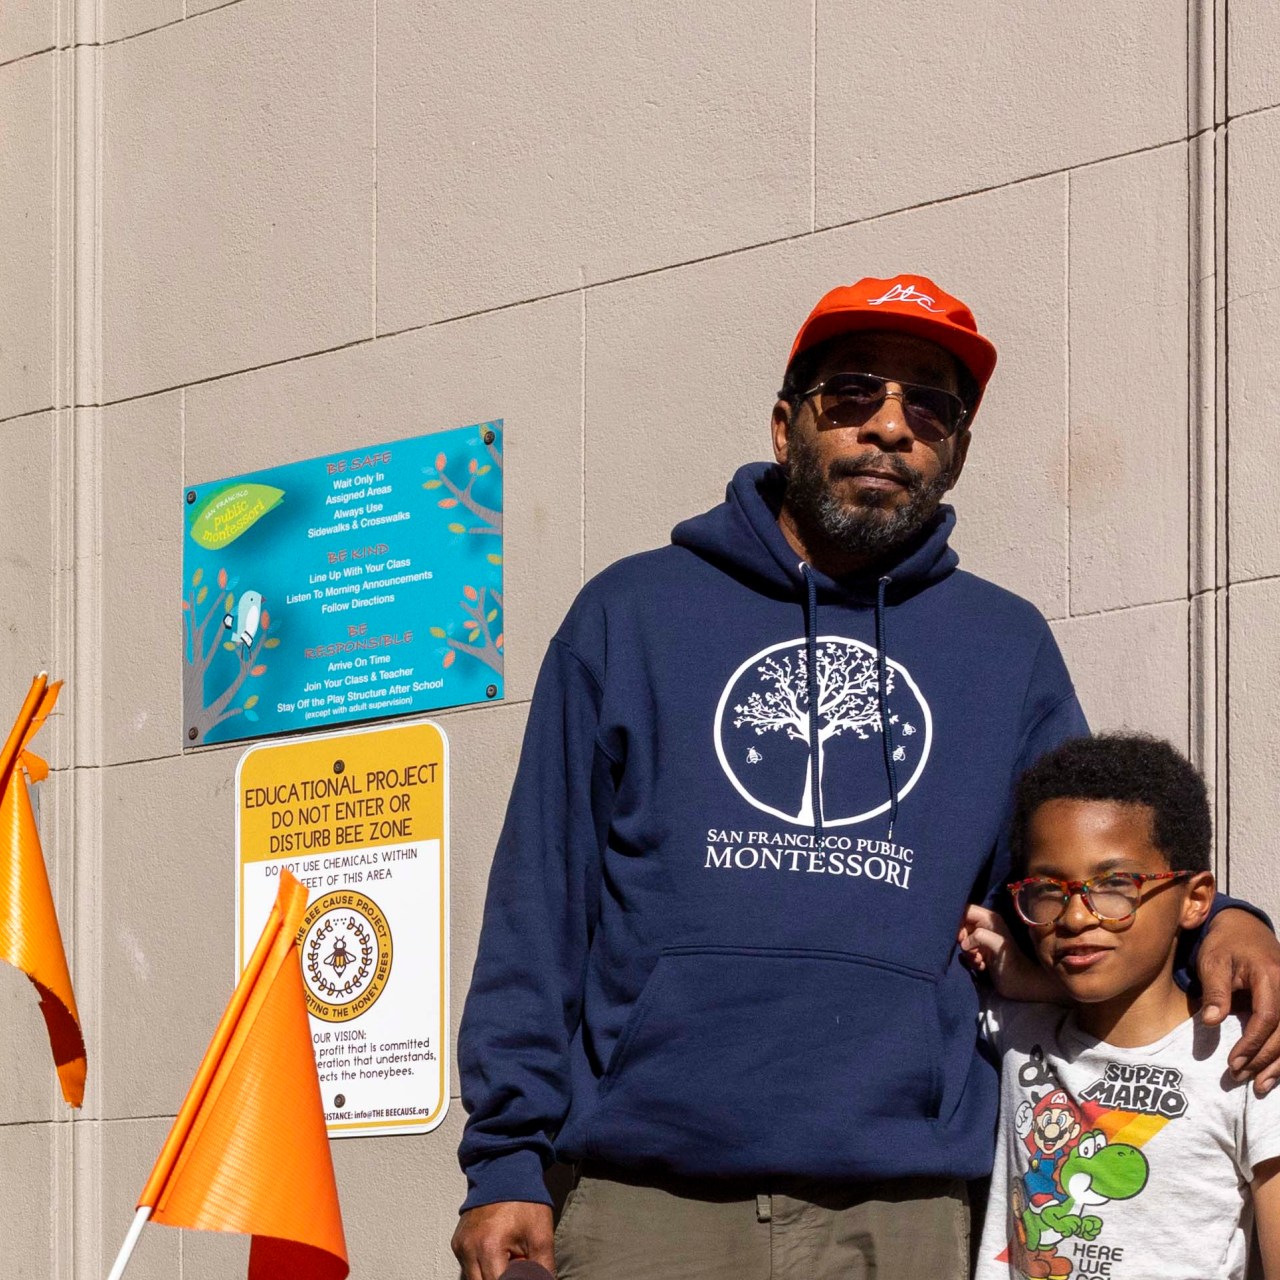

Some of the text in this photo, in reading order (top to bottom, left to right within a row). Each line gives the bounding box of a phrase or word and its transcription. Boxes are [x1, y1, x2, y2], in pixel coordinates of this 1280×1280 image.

[326, 450, 392, 475] BE SAFE
[333, 473, 384, 490] Wait Only In
[326, 485, 392, 505] Assigned Areas
[308, 511, 410, 538] Sidewalks & Crosswalks
[334, 503, 383, 520] Always Use
[327, 543, 389, 564] BE KIND
[310, 558, 411, 584] Line Up With Your Class
[286, 571, 433, 604] Listen To Morning Announcements
[321, 594, 395, 614] Follow Directions
[347, 623, 367, 637] BE
[304, 630, 413, 660] RESPONSIBLE
[328, 654, 391, 672] Arrive On Time
[304, 667, 414, 693] Join Your Class & Teacher
[277, 678, 443, 713] Stay Off the Play Structure After School
[245, 763, 438, 809] EDUCATIONAL PROJECT
[272, 793, 410, 829] DO NOT ENTER OR
[270, 817, 413, 854] DISTURB BEE ZONE
[707, 829, 743, 843] SAN
[856, 838, 914, 863] PUBLIC
[265, 865, 279, 877] DO
[303, 860, 320, 872] USE
[323, 852, 378, 870] CHEMICALS
[381, 848, 418, 862] WITHIN
[704, 845, 912, 890] MONTESSORI
[327, 874, 340, 886] OF
[343, 871, 363, 884] THIS
[367, 868, 393, 882] AREA
[304, 906, 321, 924] BEE
[322, 895, 354, 908] CAUSE
[356, 898, 387, 938] PROJECT
[332, 952, 389, 1017] THE HONEY BEES
[313, 1030, 367, 1044] OUR VISION:
[319, 1037, 430, 1059] profit that is committed
[353, 1050, 437, 1066] that understands,
[341, 1066, 415, 1080] the honeybees.
[1104, 1062, 1183, 1090] SUPER
[1079, 1081, 1188, 1119] MARIO
[1073, 1242, 1124, 1262] HERE
[1078, 1259, 1113, 1276] WE
